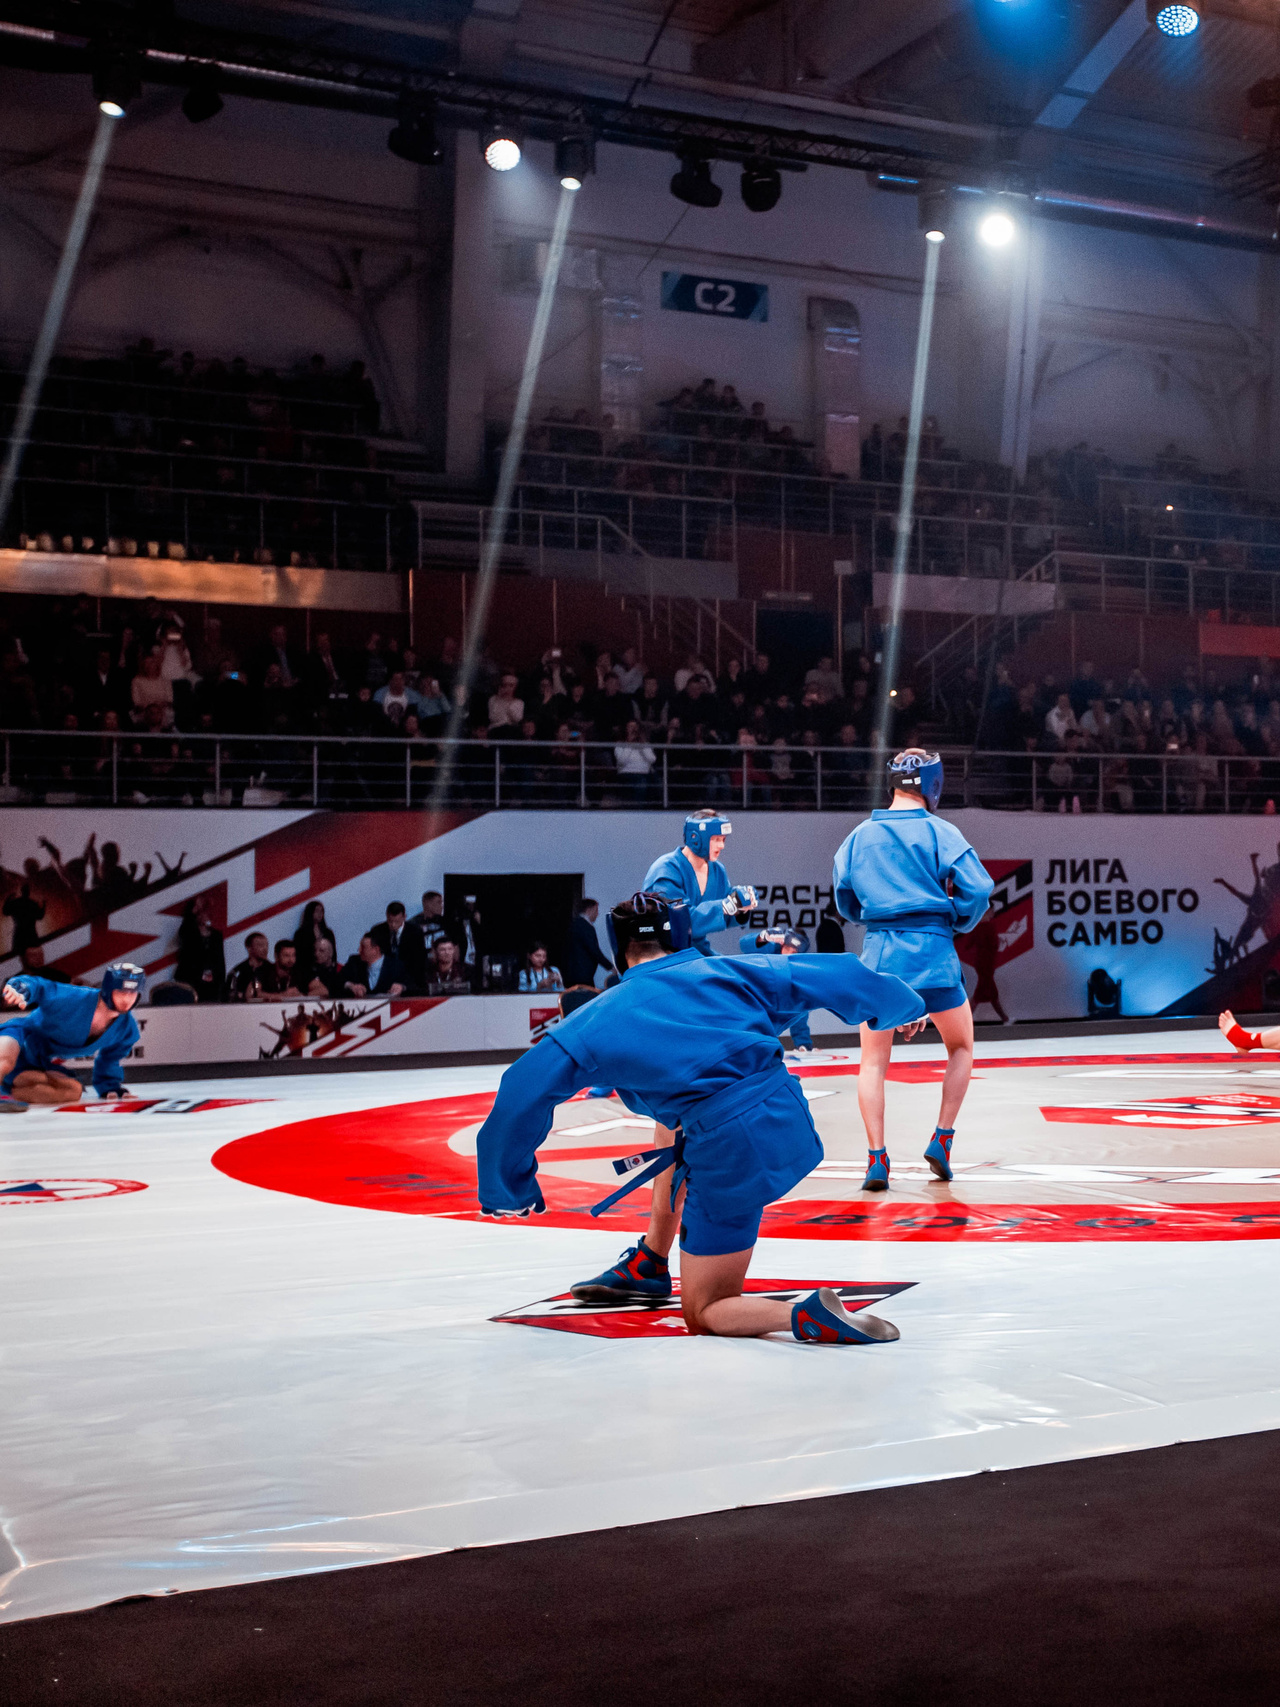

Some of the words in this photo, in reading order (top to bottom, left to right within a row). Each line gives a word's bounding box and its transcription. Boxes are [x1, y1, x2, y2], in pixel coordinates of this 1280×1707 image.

[1044, 858, 1128, 884] ЛИГА
[1047, 887, 1199, 916] БОЕВОГО
[1047, 919, 1163, 947] САМБО
